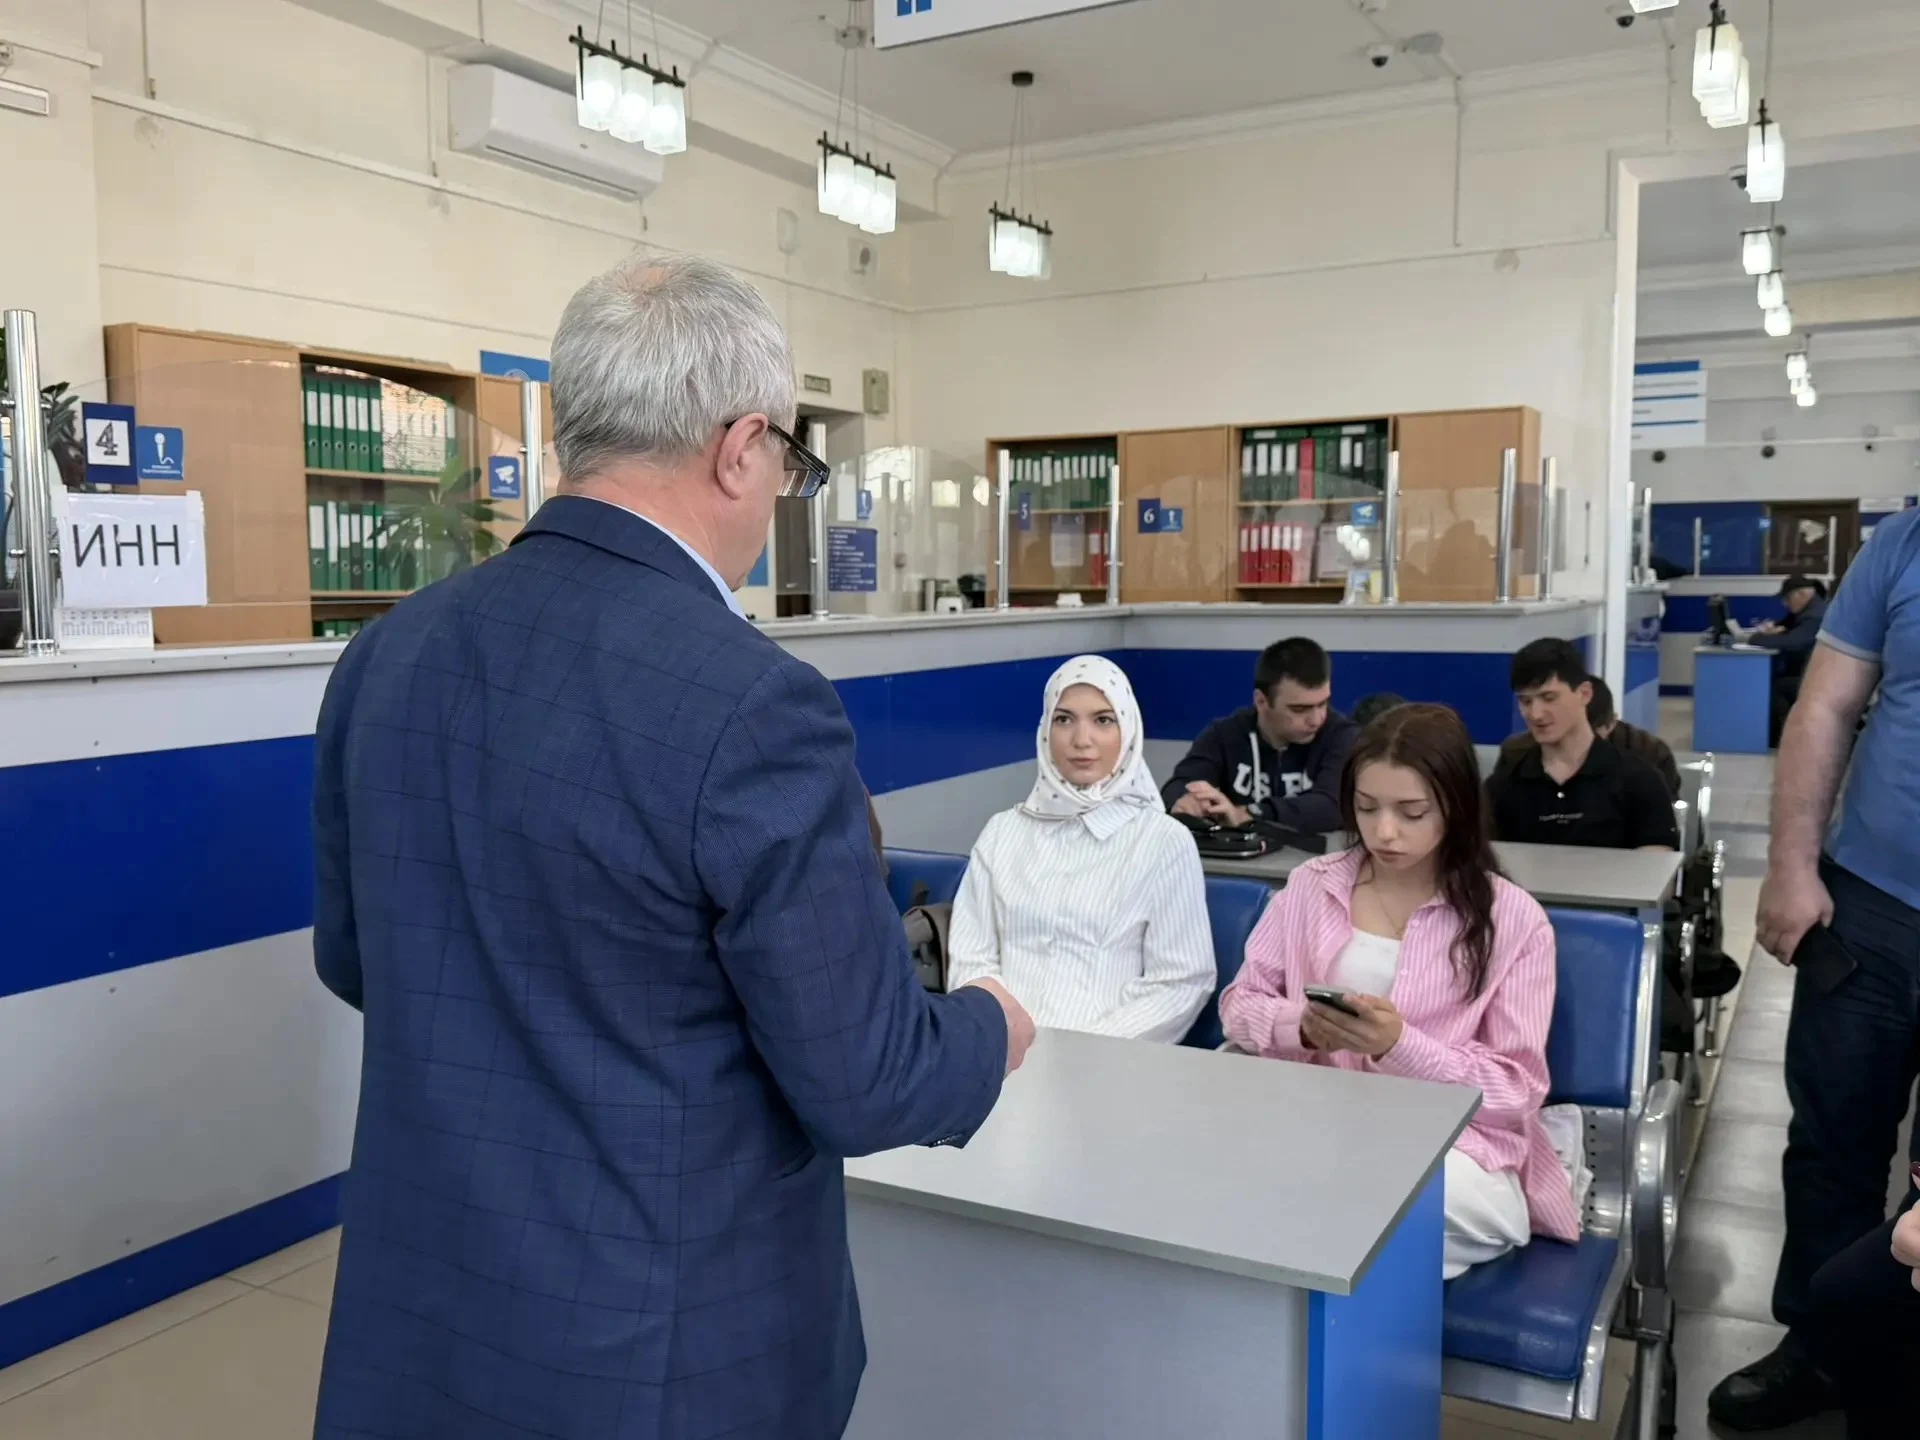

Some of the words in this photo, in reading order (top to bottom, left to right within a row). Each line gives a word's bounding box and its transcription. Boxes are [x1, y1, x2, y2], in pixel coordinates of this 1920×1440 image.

[96, 422, 118, 456] 4
[1020, 502, 1030, 520] 5
[1143, 508, 1155, 524] 6
[73, 524, 180, 567] ИНН
